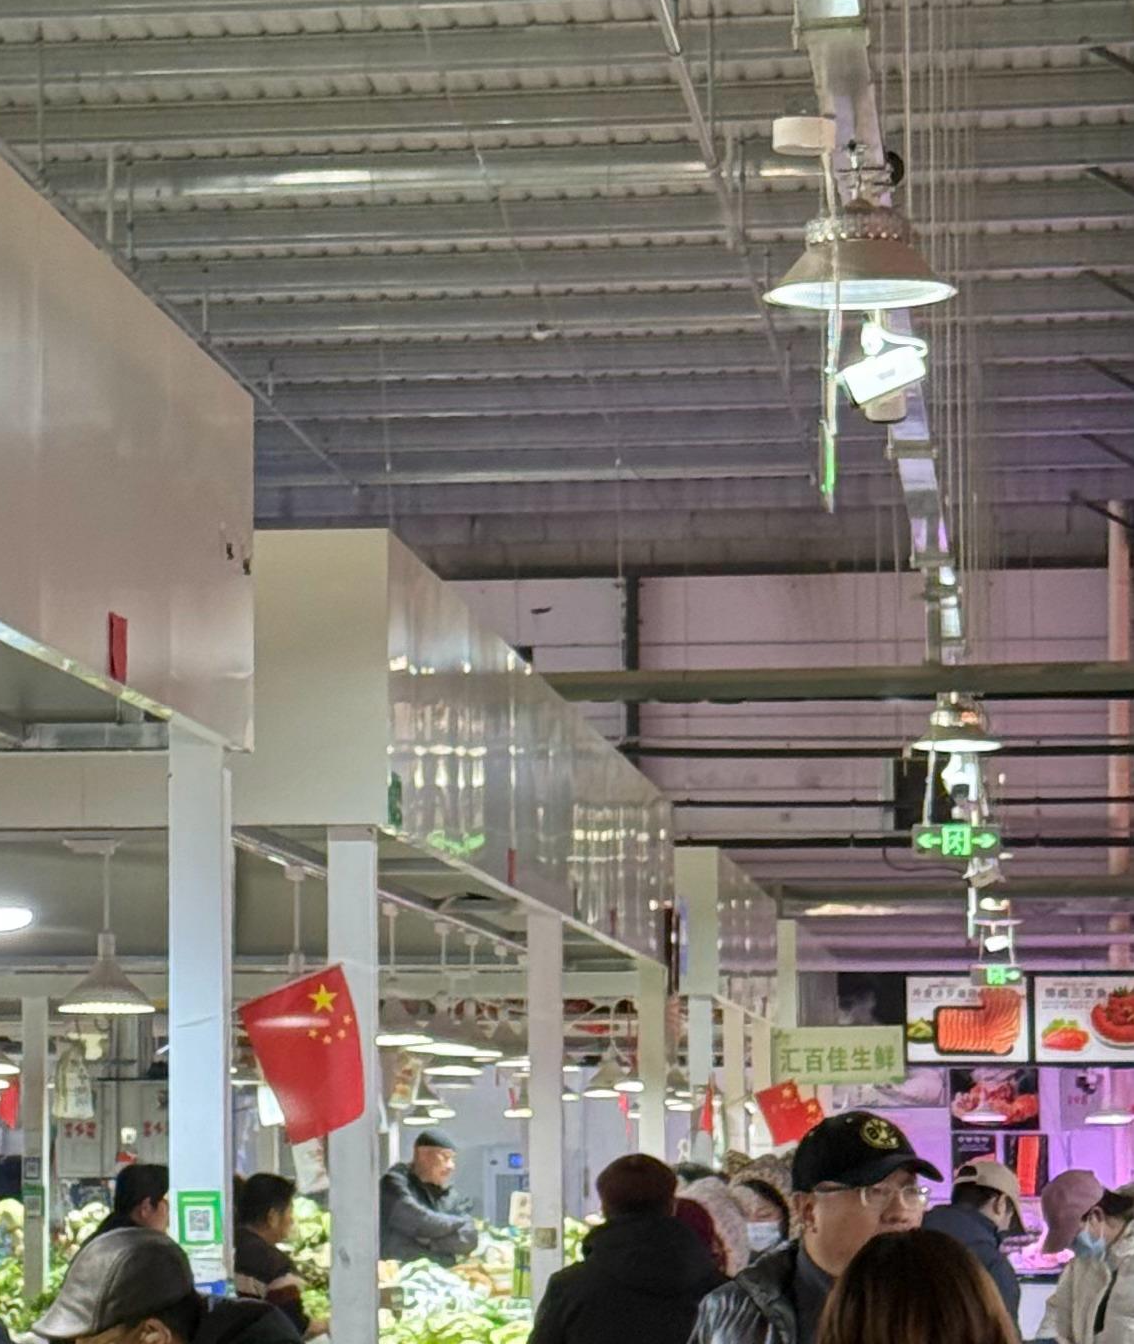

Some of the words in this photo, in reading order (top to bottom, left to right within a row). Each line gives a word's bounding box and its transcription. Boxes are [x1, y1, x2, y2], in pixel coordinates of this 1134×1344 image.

[780, 1045, 896, 1072] 汇百佳生鲜
